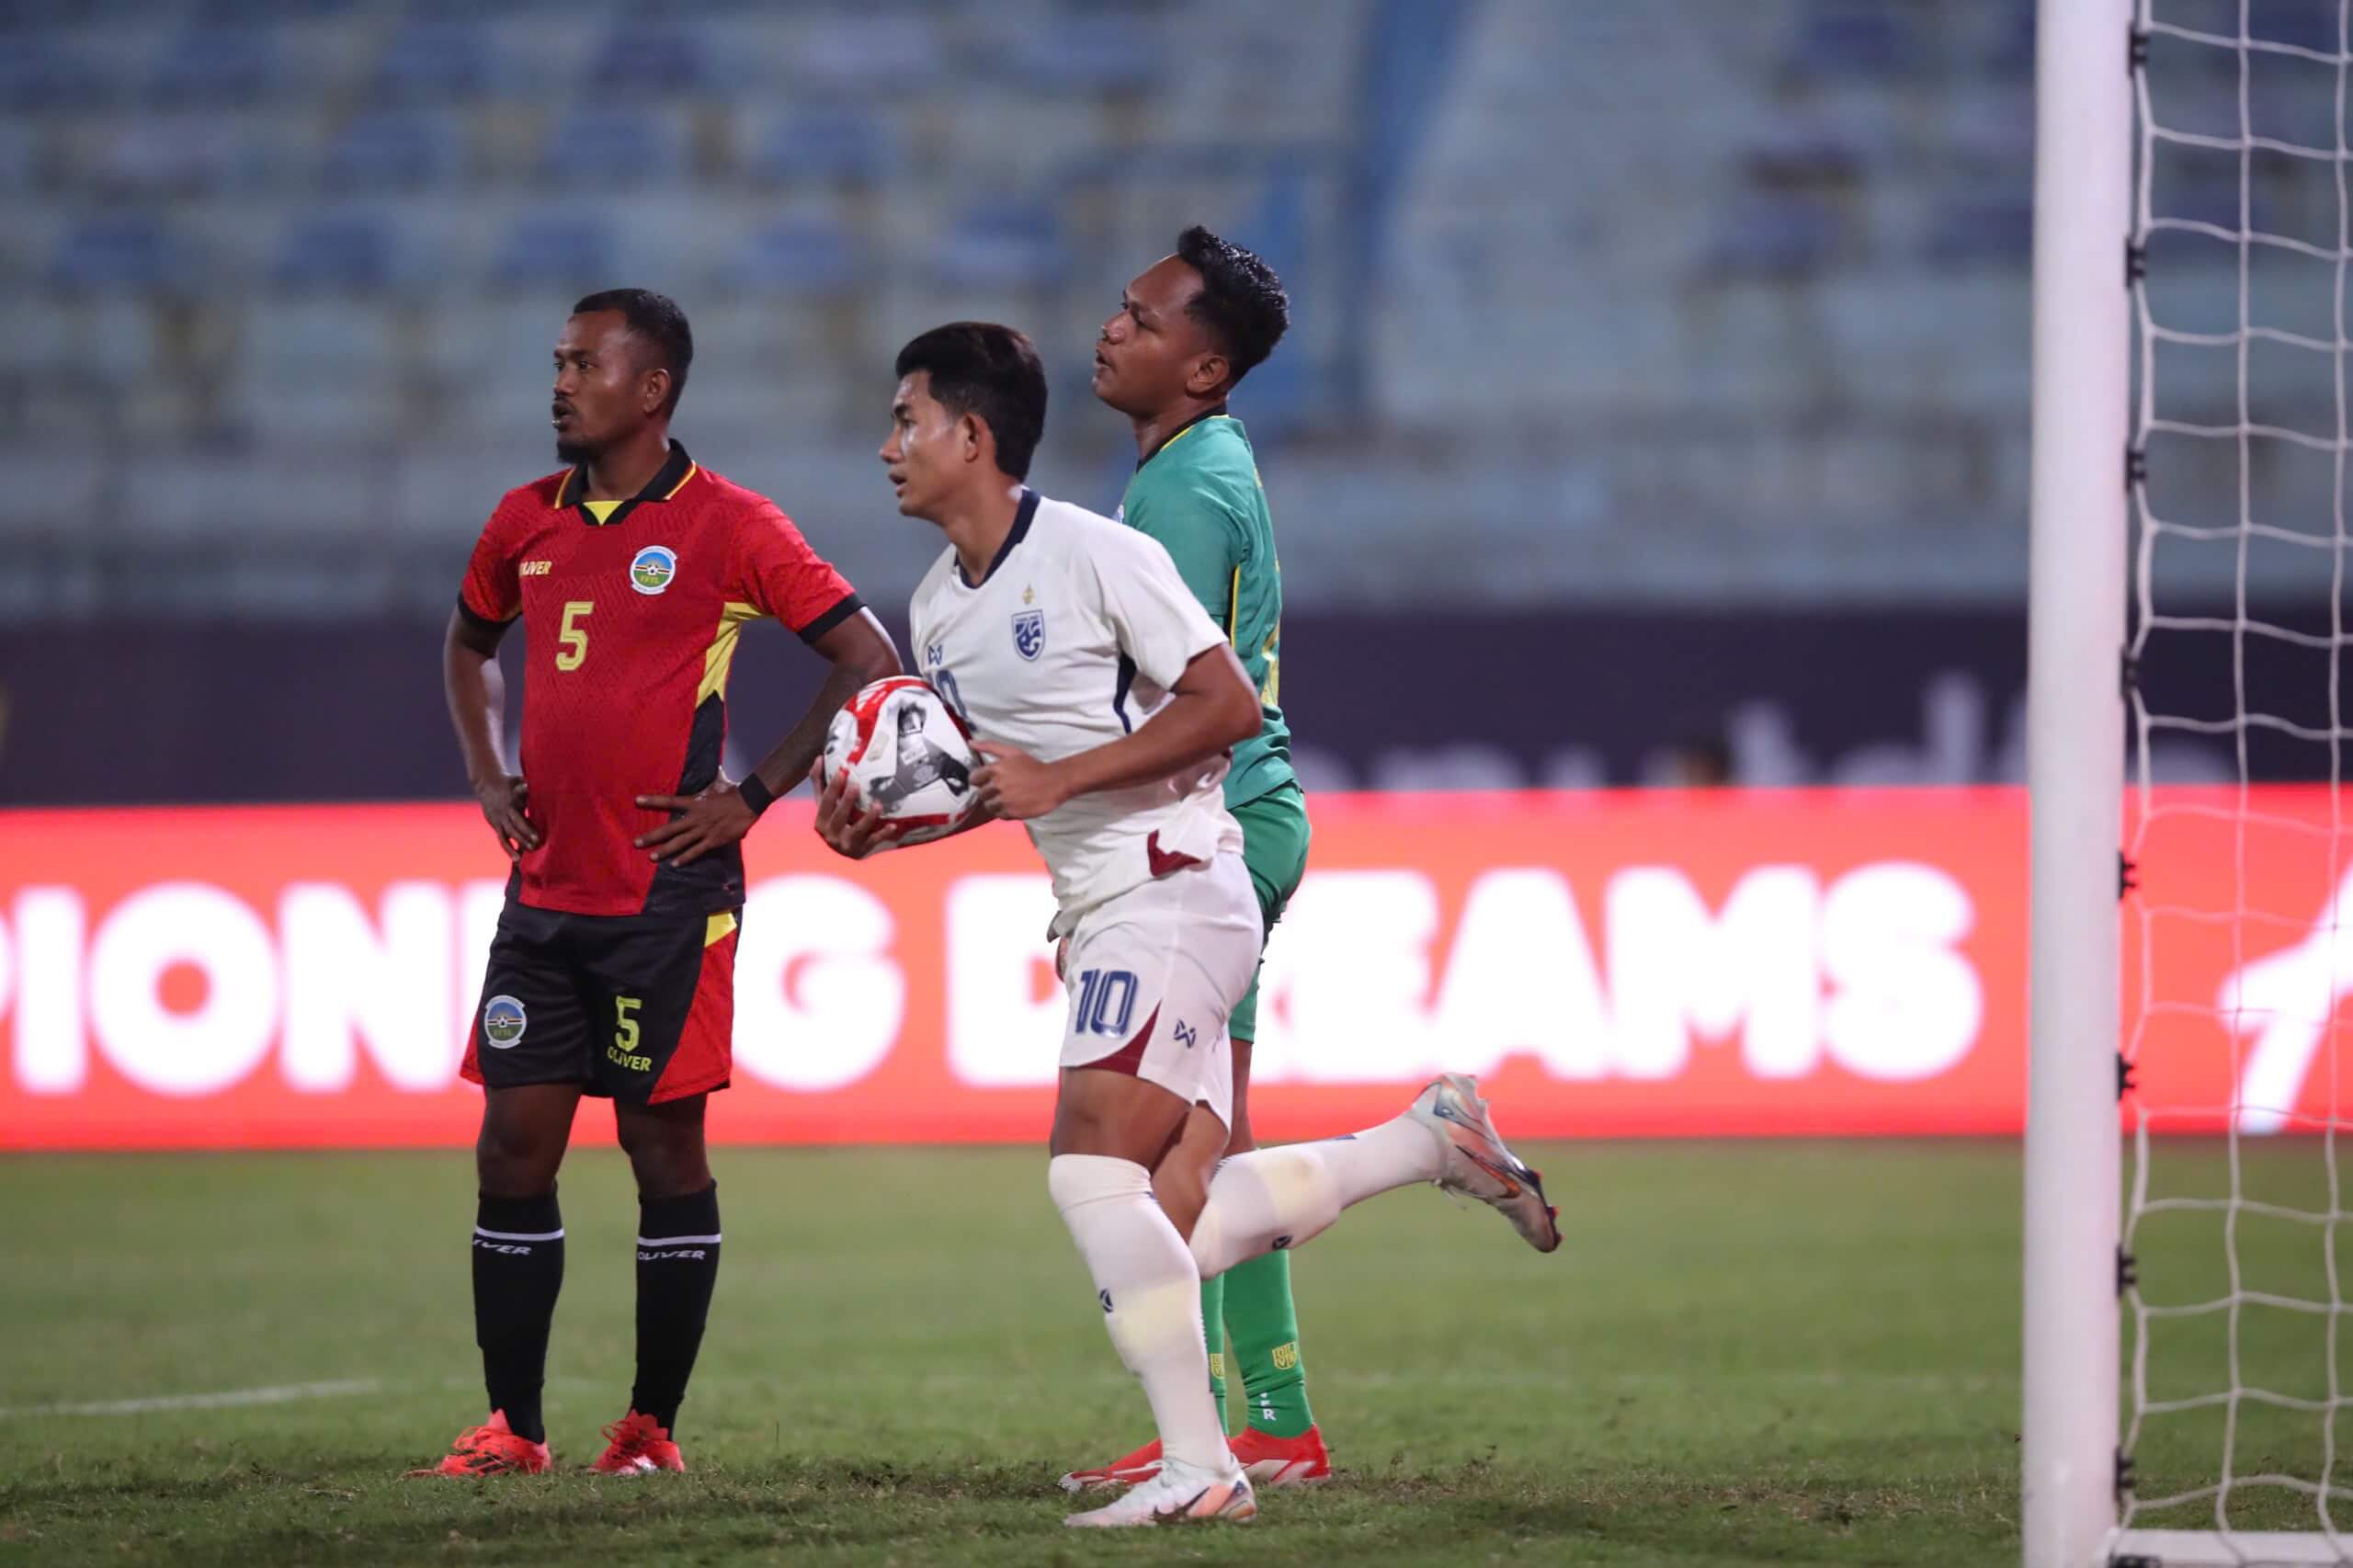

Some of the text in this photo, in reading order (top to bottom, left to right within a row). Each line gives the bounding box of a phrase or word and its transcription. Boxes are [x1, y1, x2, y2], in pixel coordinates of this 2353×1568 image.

[556, 601, 595, 671] 5
[0, 864, 1984, 1096] IONG DEAMS
[1075, 969, 1138, 1038] 10
[615, 995, 642, 1051] 5
[607, 1046, 653, 1072] OLIVER
[638, 1250, 707, 1260] OLIVER
